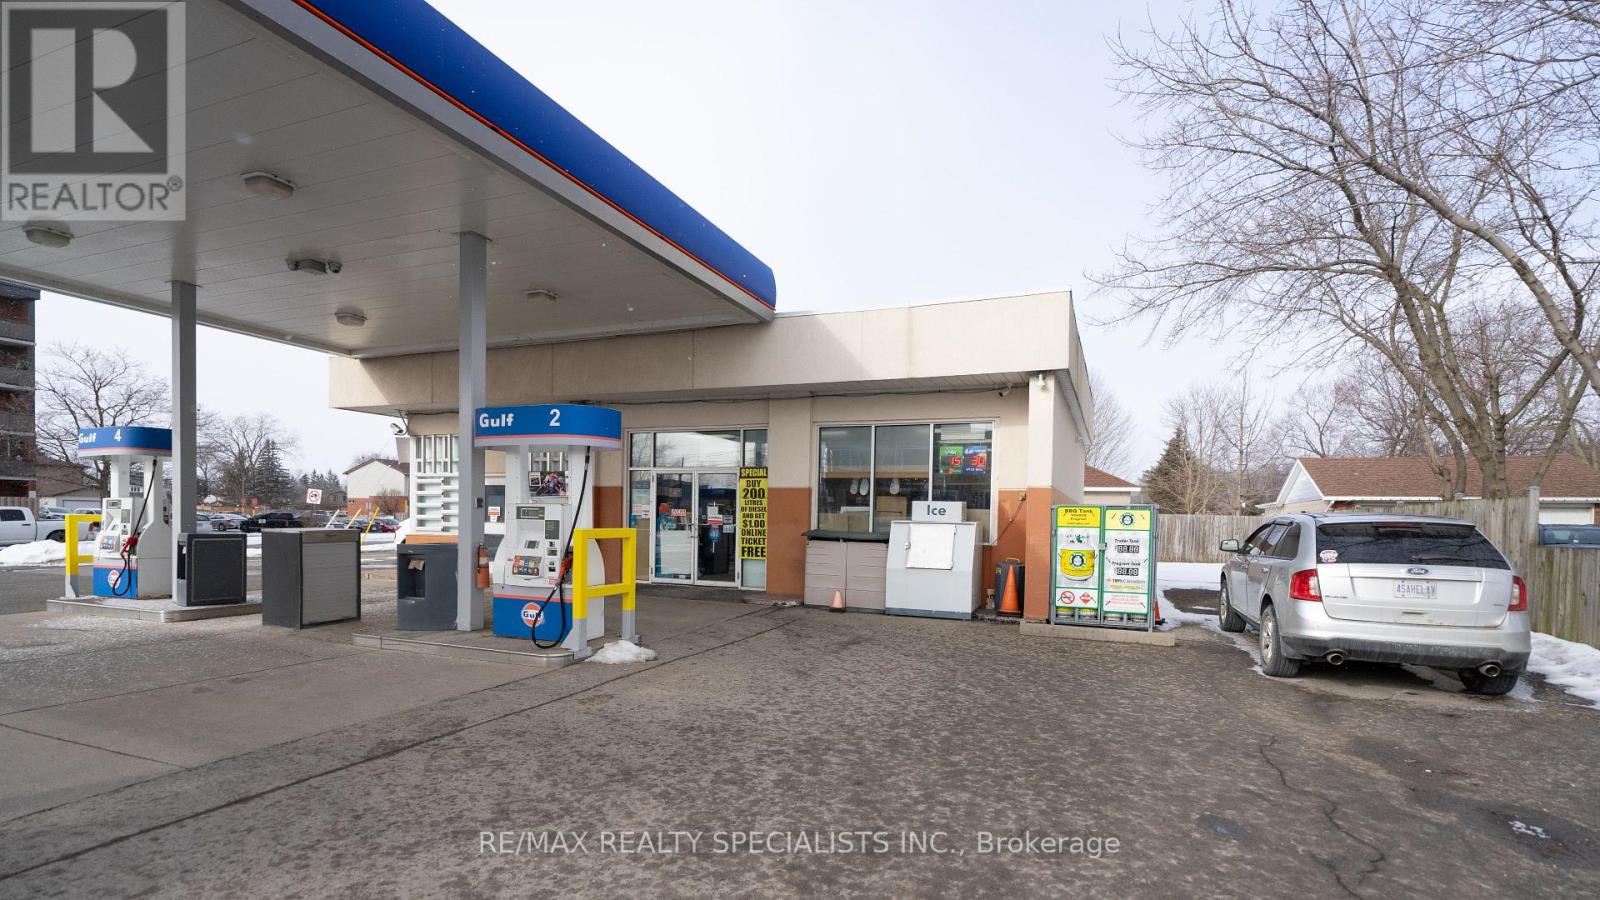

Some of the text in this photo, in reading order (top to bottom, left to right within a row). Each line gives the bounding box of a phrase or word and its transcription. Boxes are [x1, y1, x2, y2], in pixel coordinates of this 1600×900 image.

[479, 408, 561, 428] Gulf 2
[79, 428, 122, 443] Gulf 4
[741, 468, 767, 477] SPECIAL
[746, 480, 761, 488] BUY
[743, 488, 766, 499] 200
[927, 504, 946, 516] Ice
[743, 519, 765, 528] $1.00
[741, 529, 766, 537] ONLINE
[741, 537, 766, 545] TICKET
[741, 546, 766, 557] FREE
